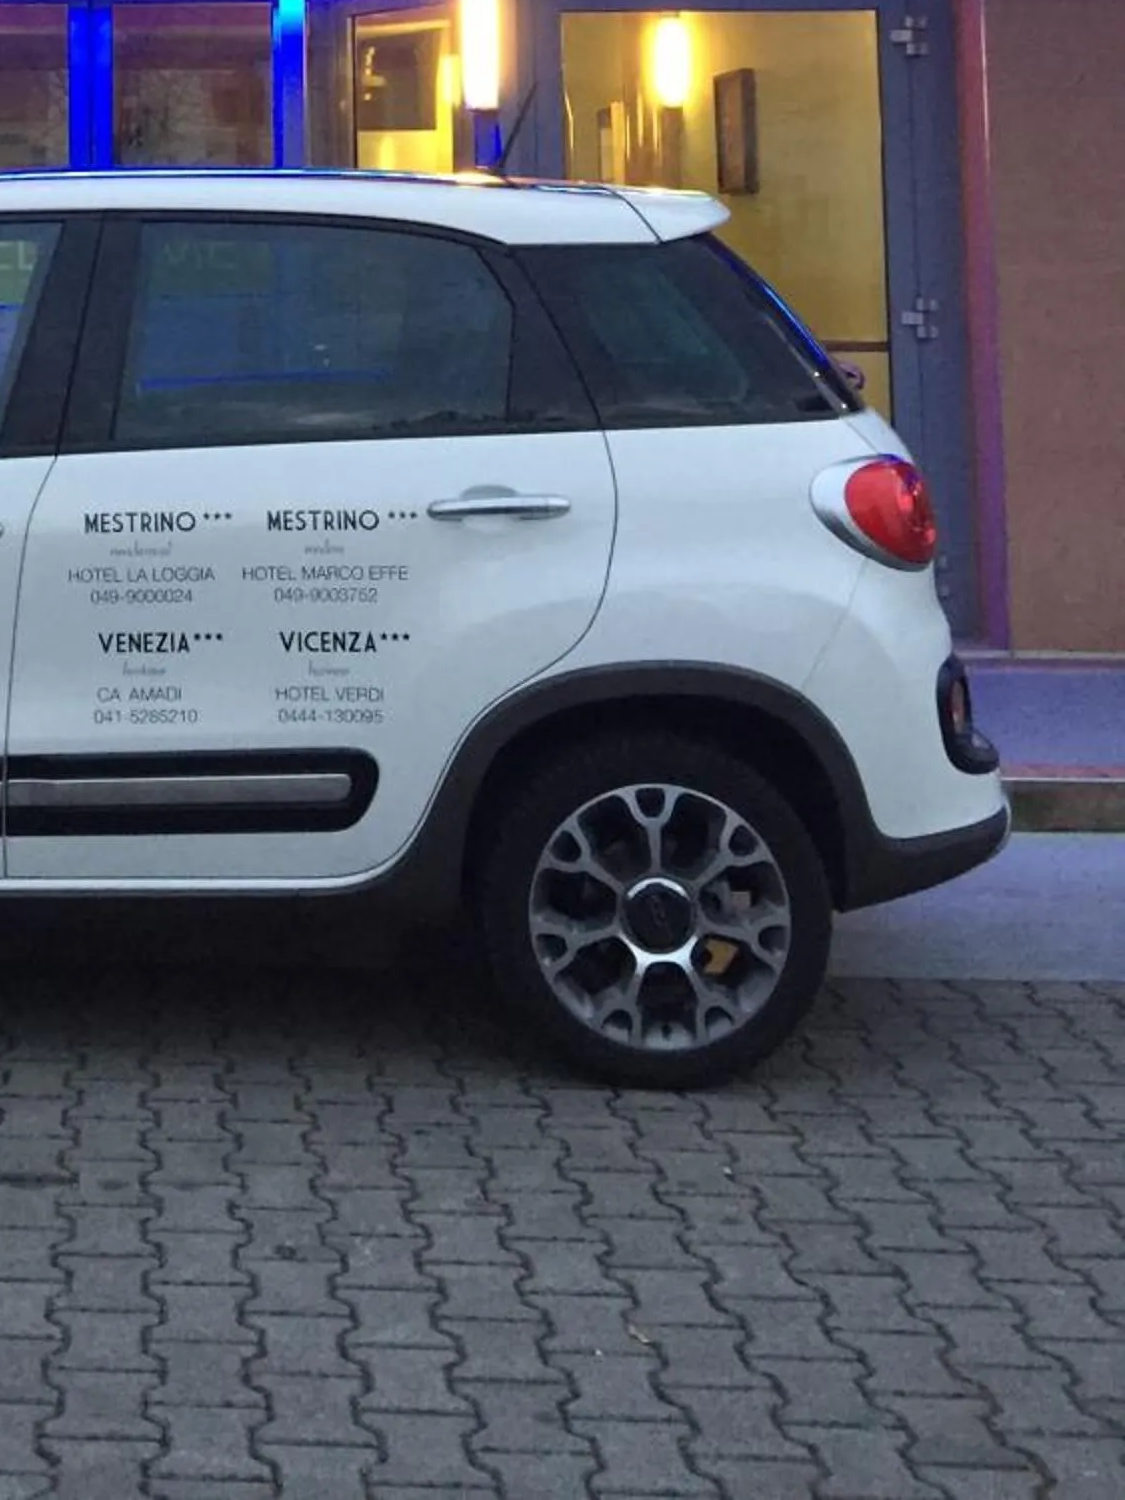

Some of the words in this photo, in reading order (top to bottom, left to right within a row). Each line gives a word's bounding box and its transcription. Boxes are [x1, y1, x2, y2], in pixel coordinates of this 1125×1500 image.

[84, 511, 196, 534] MESTRINO
[267, 509, 380, 532] MESTRINO
[68, 568, 123, 583] HOTEL
[126, 568, 150, 583] LA
[152, 566, 216, 582] LOGGIA
[242, 566, 296, 581] HOTEL
[302, 566, 365, 582] MARCO
[368, 565, 409, 581] EFFE
[98, 632, 190, 654] VENEZIA
[279, 631, 377, 653] VICENZA
[128, 686, 182, 702] AMADI
[275, 687, 330, 702] HOTEL
[334, 686, 384, 702] VERDI
